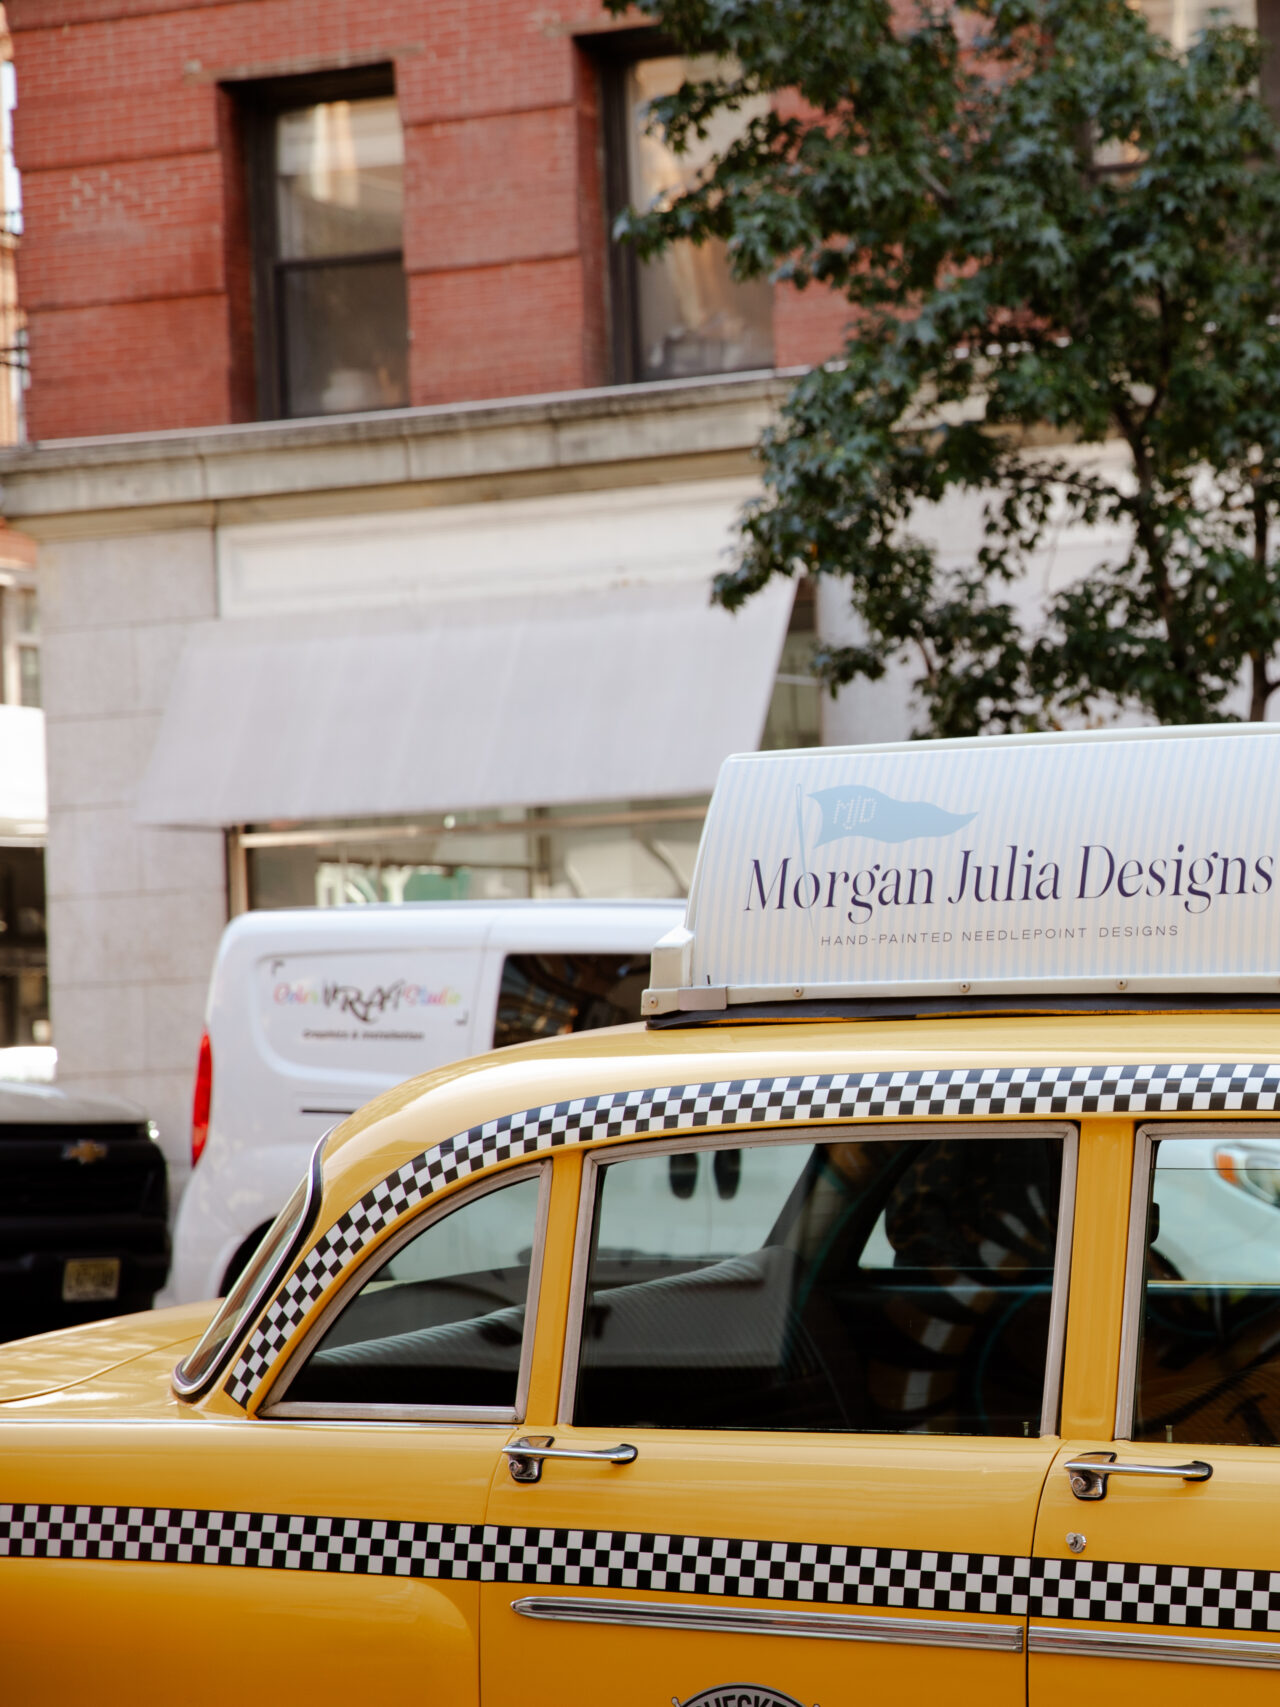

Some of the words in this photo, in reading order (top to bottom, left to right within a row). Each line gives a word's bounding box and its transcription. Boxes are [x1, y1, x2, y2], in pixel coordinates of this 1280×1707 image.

[832, 795, 878, 830] MJD
[744, 857, 935, 925] Morgan
[947, 845, 1063, 904] Julia
[1075, 843, 1274, 914] Designs
[820, 931, 954, 947] HAND-PAINTED
[961, 927, 1087, 943] NEEDLEPOINT
[1098, 924, 1179, 939] DESIGNS
